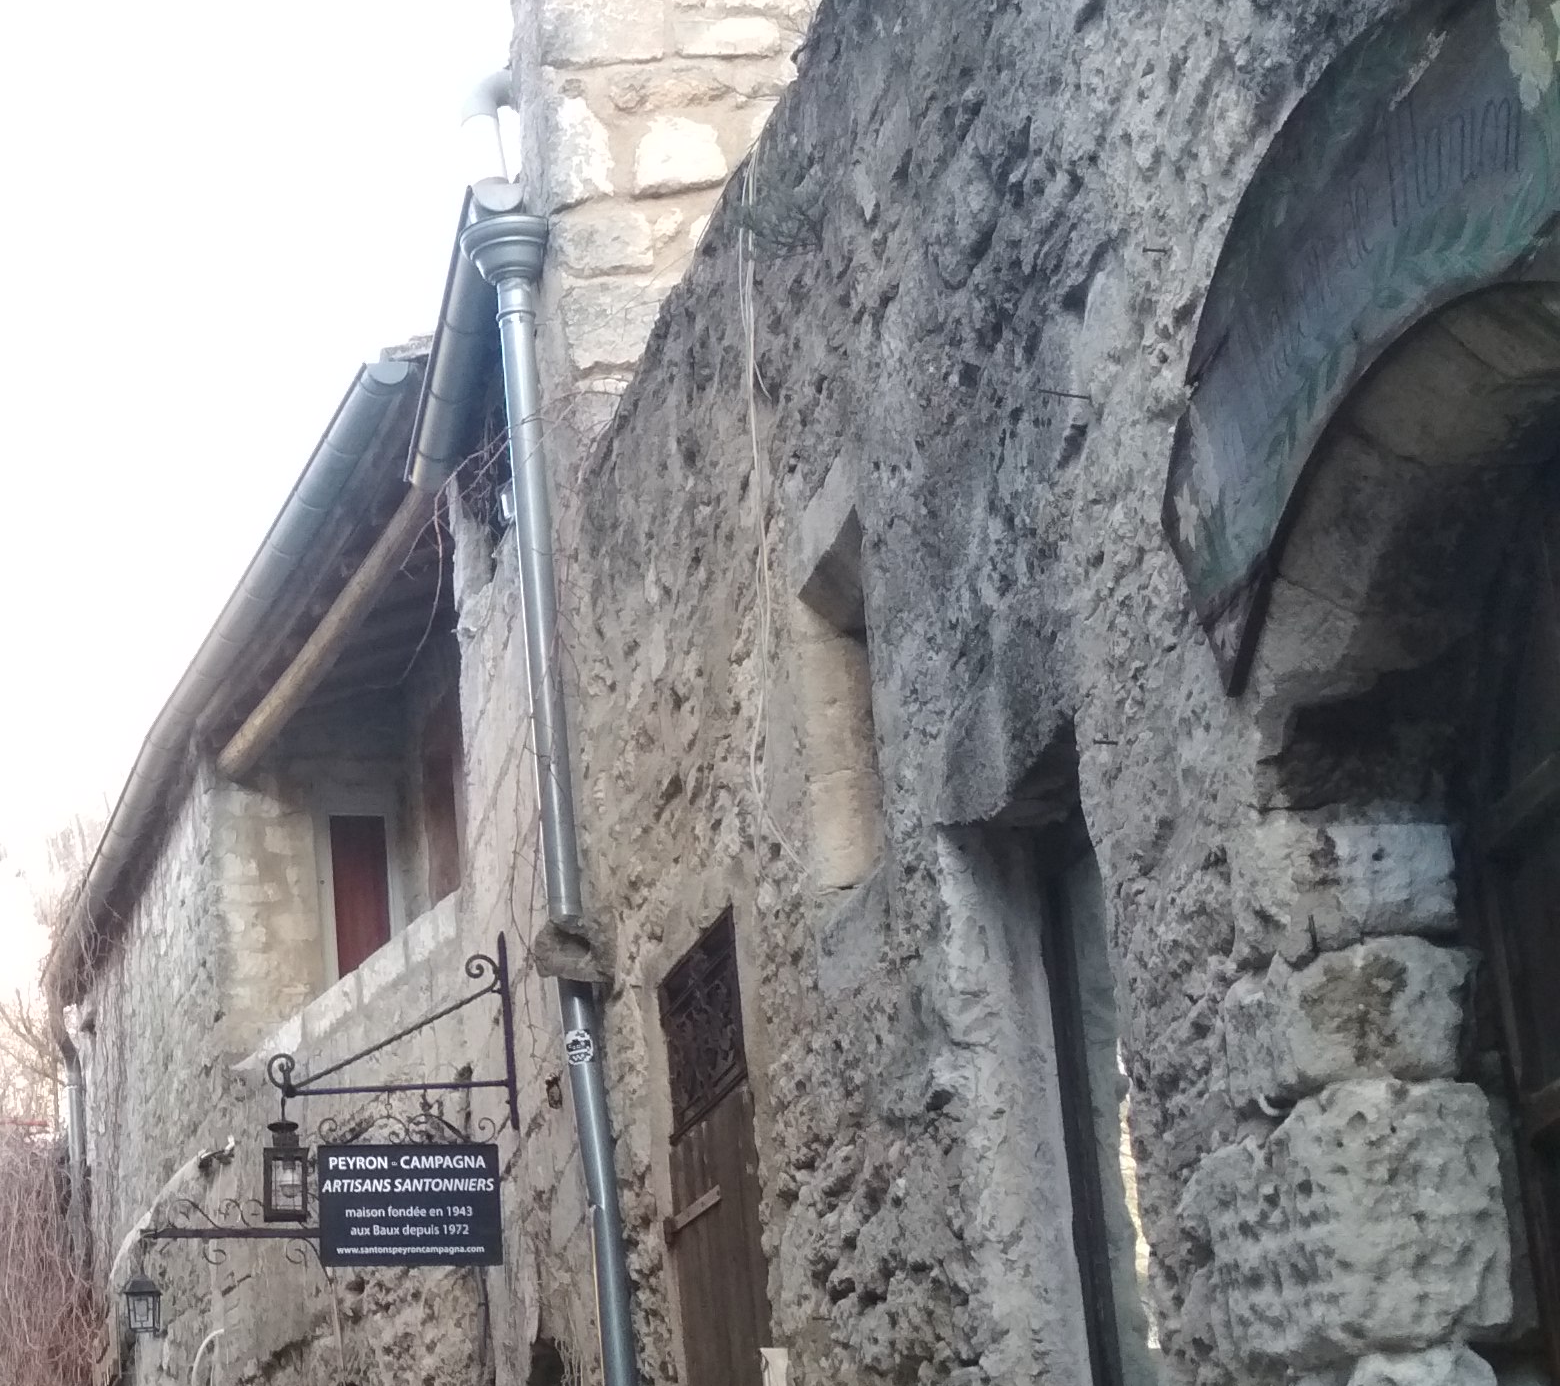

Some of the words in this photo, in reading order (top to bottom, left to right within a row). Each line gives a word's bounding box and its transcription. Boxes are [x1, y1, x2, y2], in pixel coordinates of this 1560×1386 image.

[329, 1156, 388, 1170] PEYRON
[400, 1155, 486, 1169] CAMPAGNA
[322, 1179, 391, 1193] ARTISANS
[394, 1178, 494, 1192] SANTONNIERS
[345, 1206, 386, 1218] maison
[388, 1205, 427, 1218] fondée
[429, 1207, 444, 1217] en
[446, 1205, 473, 1217] 1943
[350, 1225, 371, 1236] aux
[373, 1224, 400, 1236] Baux
[402, 1224, 440, 1238] depuis
[442, 1224, 470, 1235] 1972
[336, 1245, 485, 1255] www.santonspeyroncampagna.com
